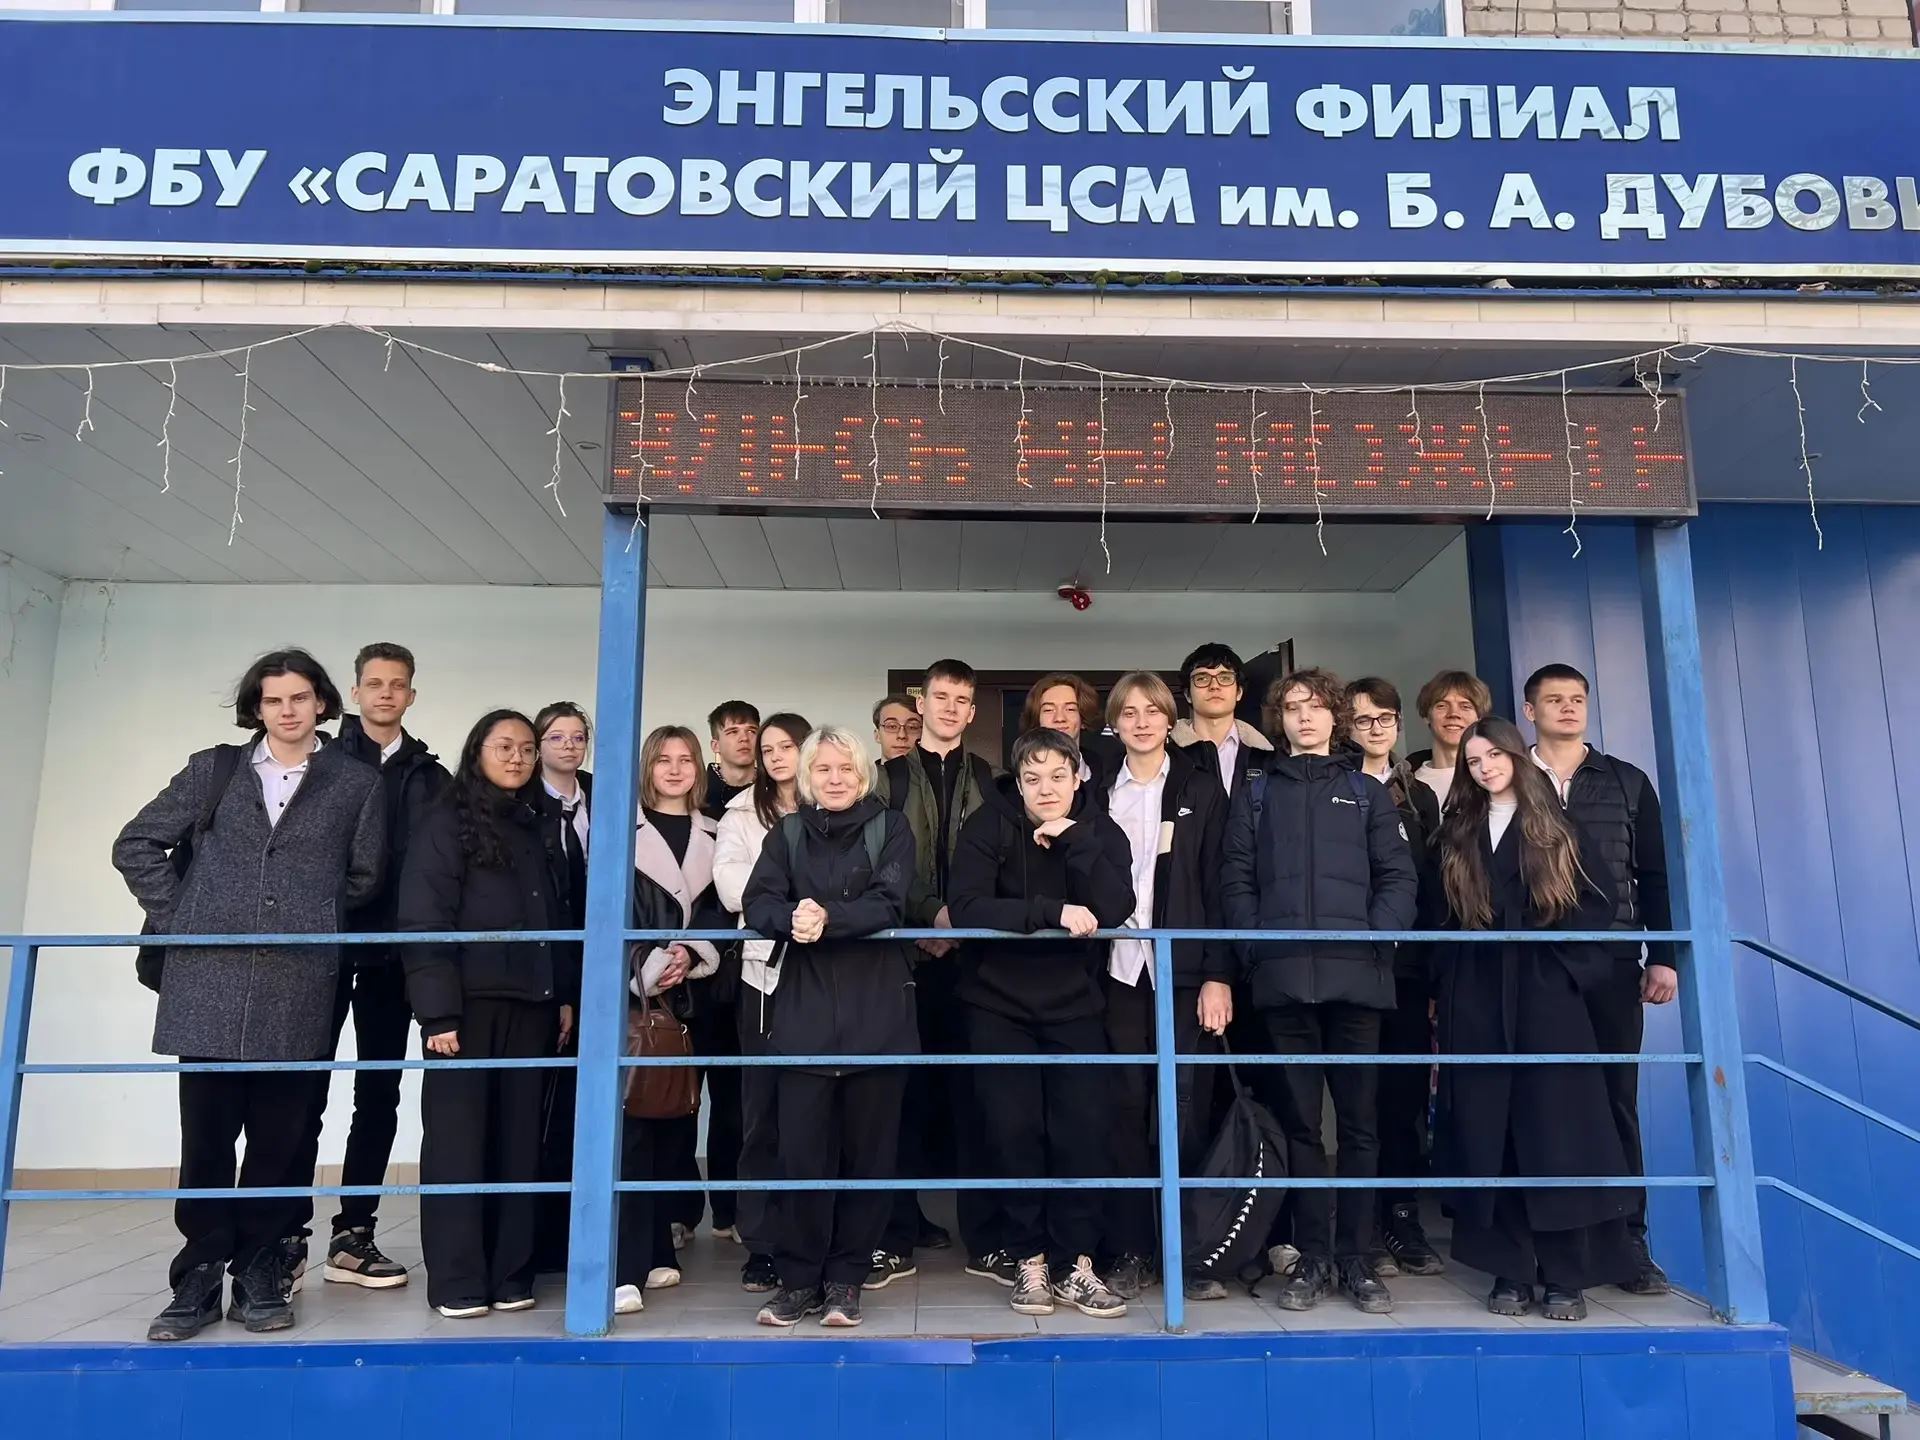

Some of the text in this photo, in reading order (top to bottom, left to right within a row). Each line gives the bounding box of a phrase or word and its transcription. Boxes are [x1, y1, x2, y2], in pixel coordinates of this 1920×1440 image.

[663, 65, 1681, 141] ЭНГЕЛЬССКИЙ ФИЛИАЛ
[68, 147, 268, 207] ФБУ
[288, 147, 978, 221] «САРАТОВСКИЙ
[1006, 164, 1196, 232] ЦСМ
[1219, 185, 1360, 229] им.
[1386, 172, 1465, 229] Б.
[1489, 172, 1576, 231] А.
